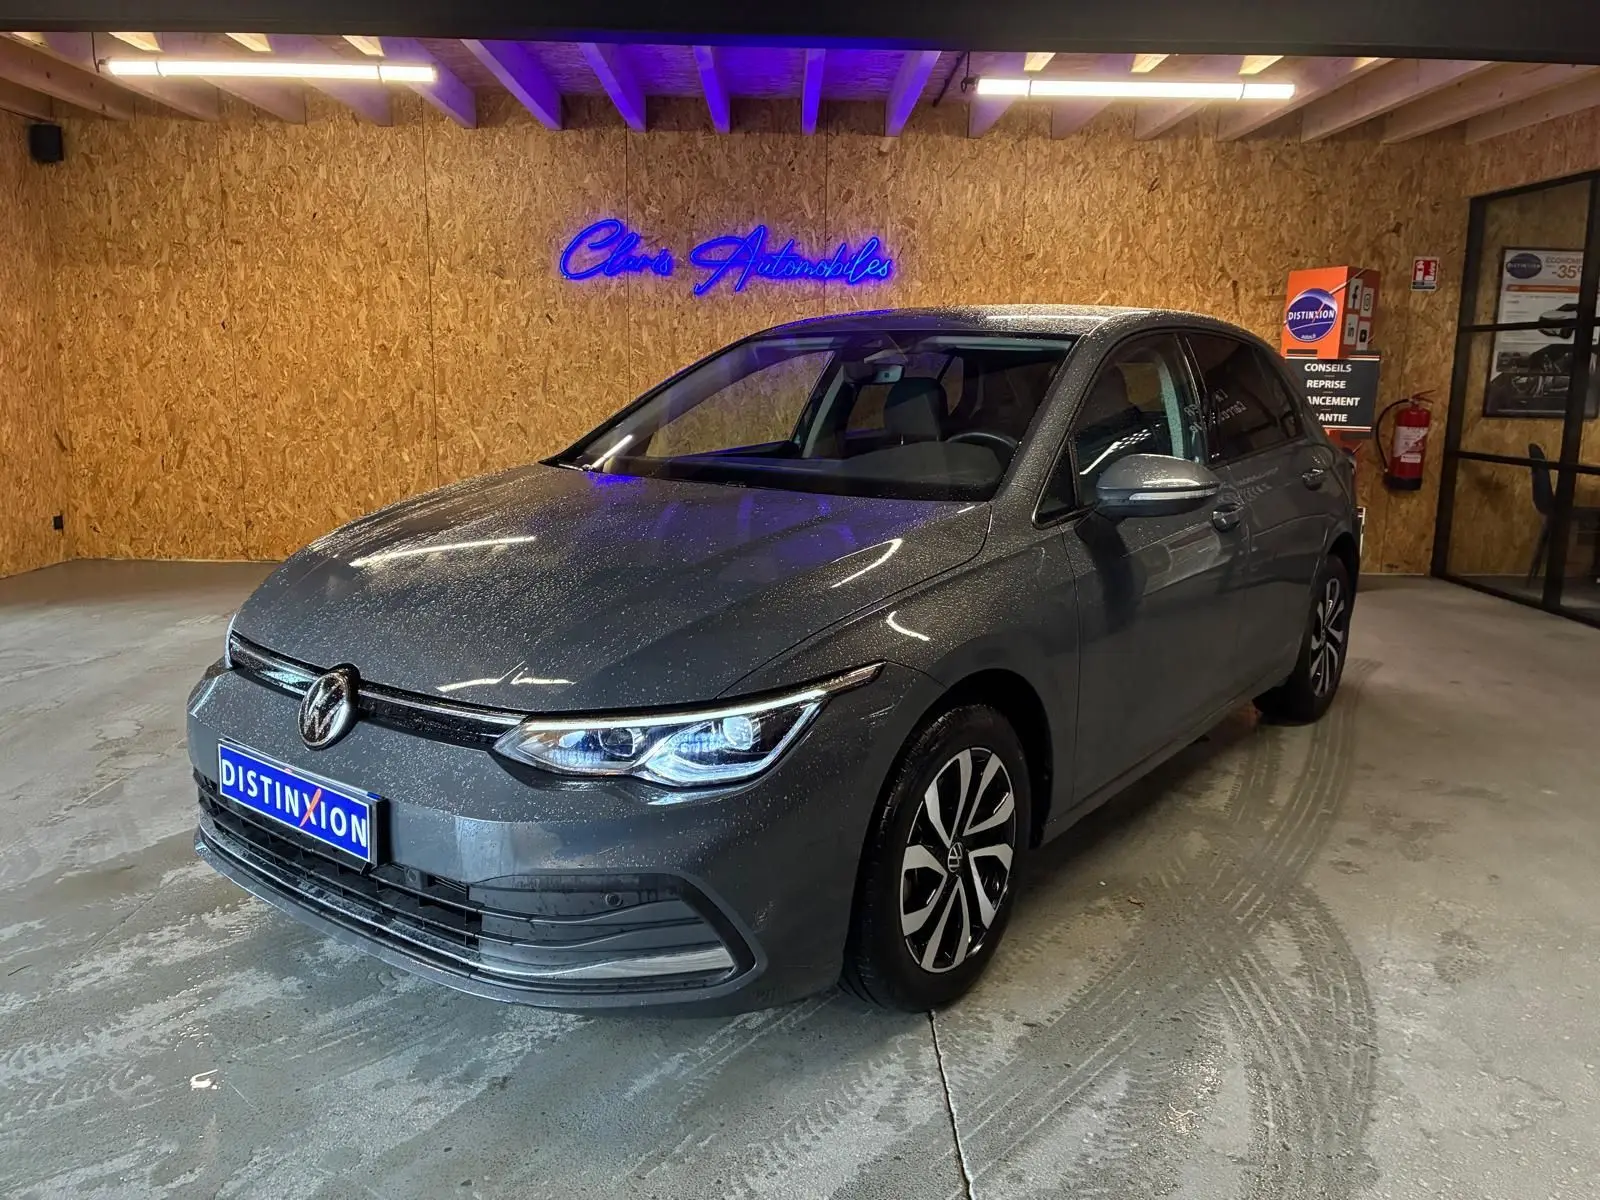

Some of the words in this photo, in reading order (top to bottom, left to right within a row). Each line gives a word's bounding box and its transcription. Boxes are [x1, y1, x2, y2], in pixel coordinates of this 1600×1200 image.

[690, 224, 893, 295] Automobiles
[1288, 309, 1335, 321] DISTINXION
[1304, 363, 1352, 373] CONSEILS
[1306, 379, 1347, 389] REPRISE
[1307, 396, 1361, 406] ANCEMENT
[1317, 413, 1349, 422] ANTIE
[221, 758, 368, 848] DISTINXION
